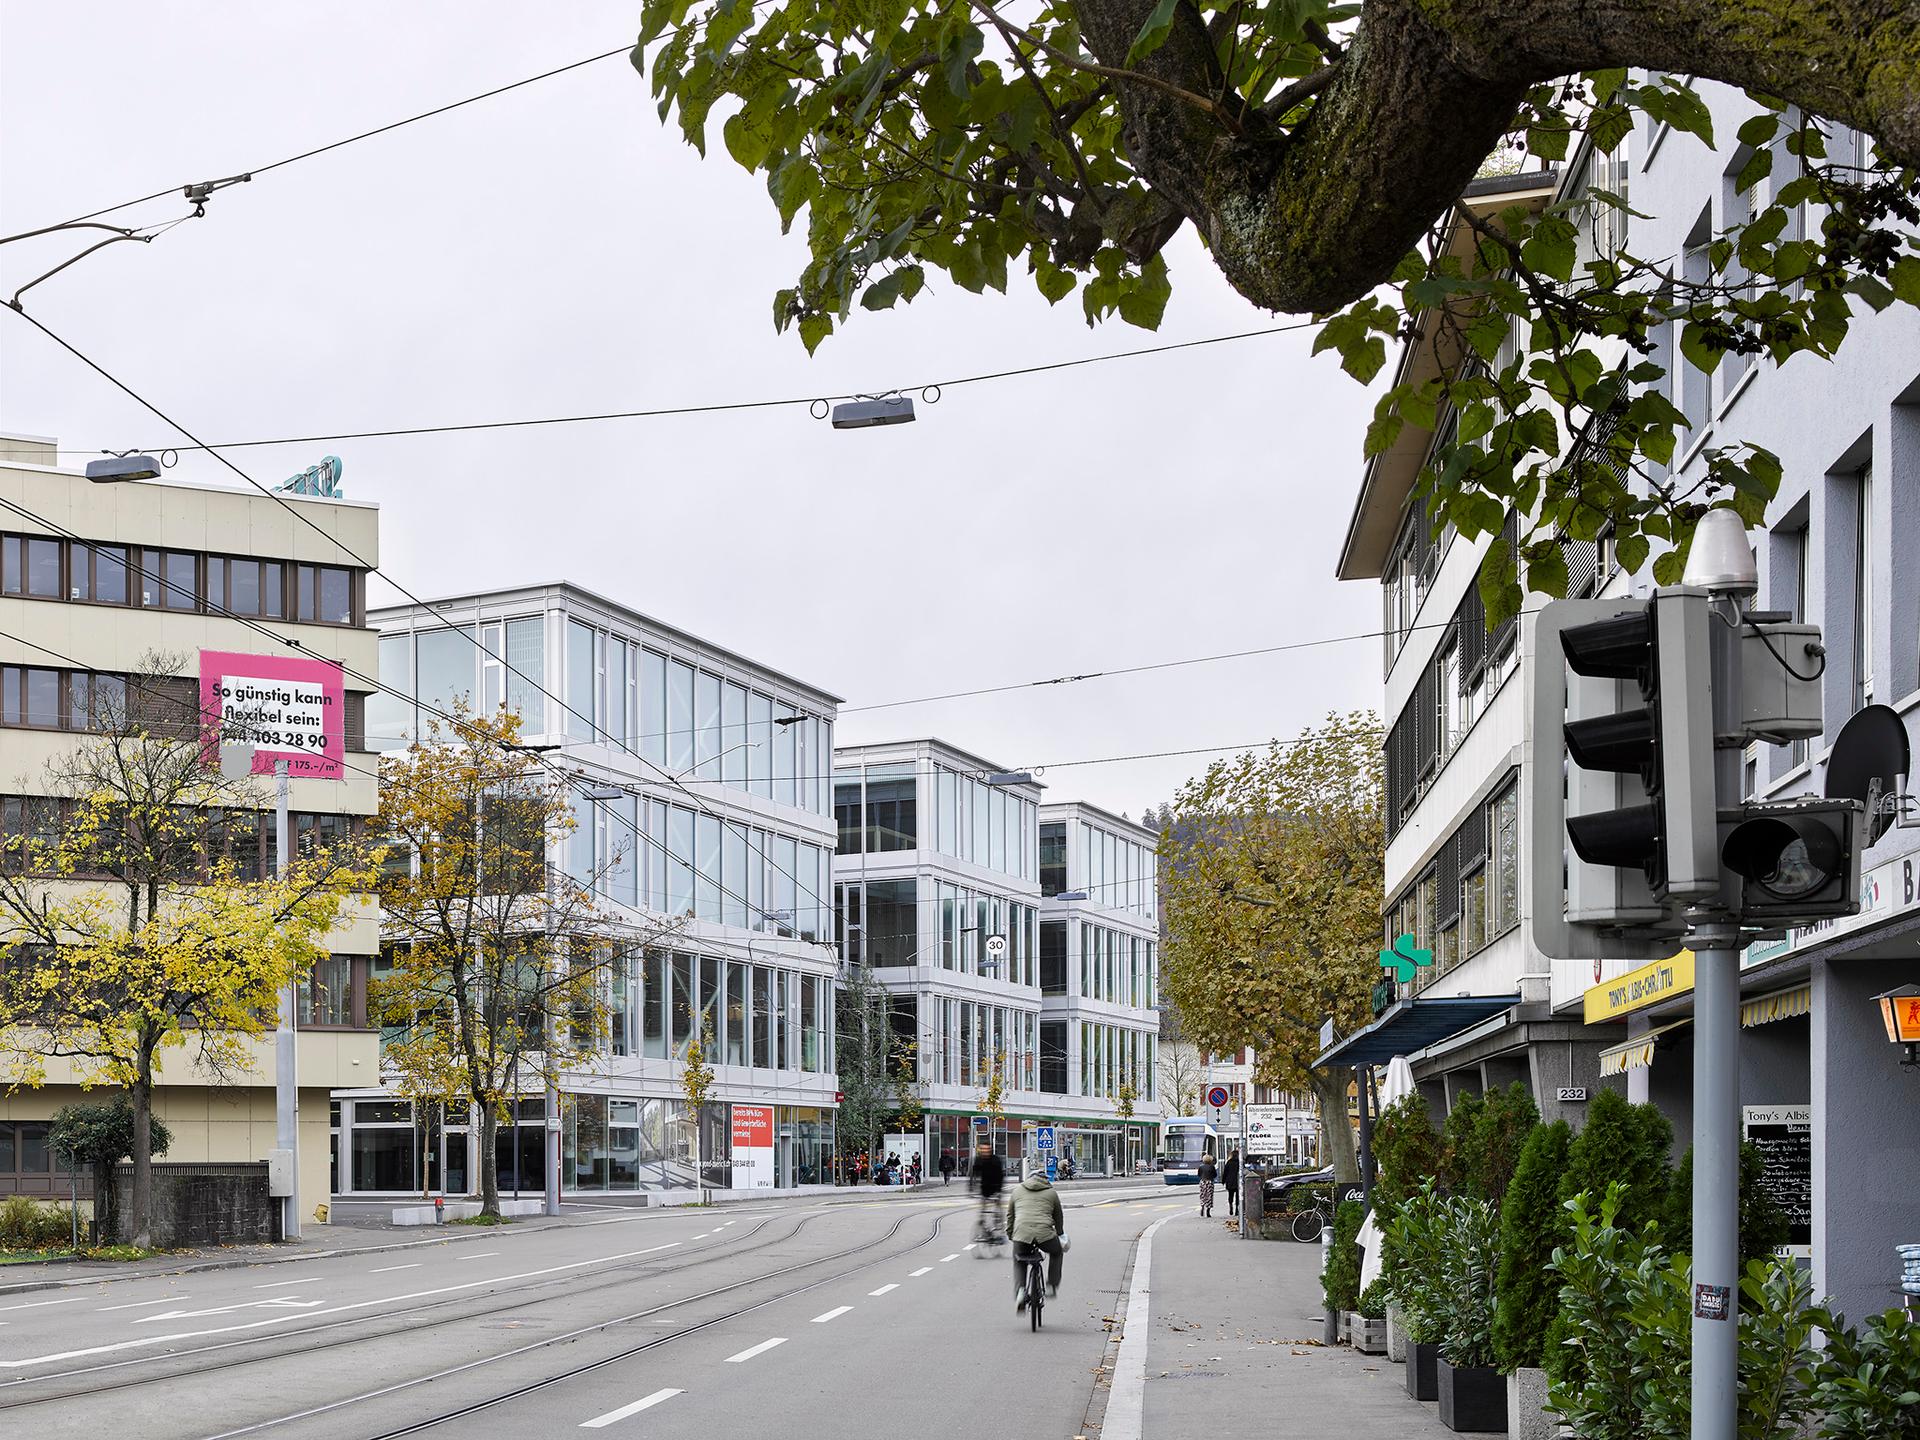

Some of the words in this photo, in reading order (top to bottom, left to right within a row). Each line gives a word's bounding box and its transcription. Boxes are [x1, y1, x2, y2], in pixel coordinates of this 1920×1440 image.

[212, 683, 232, 697] So
[235, 686, 291, 705] günstig
[295, 689, 332, 705] kann
[225, 705, 282, 724] flexibel
[286, 712, 320, 726] sein:
[285, 733, 304, 747] 28
[308, 735, 328, 748] 90
[988, 940, 1003, 950] 30
[1561, 1090, 1584, 1098] 232
[1747, 1110, 1779, 1122] Tony's
[1785, 1111, 1810, 1120] Albis
